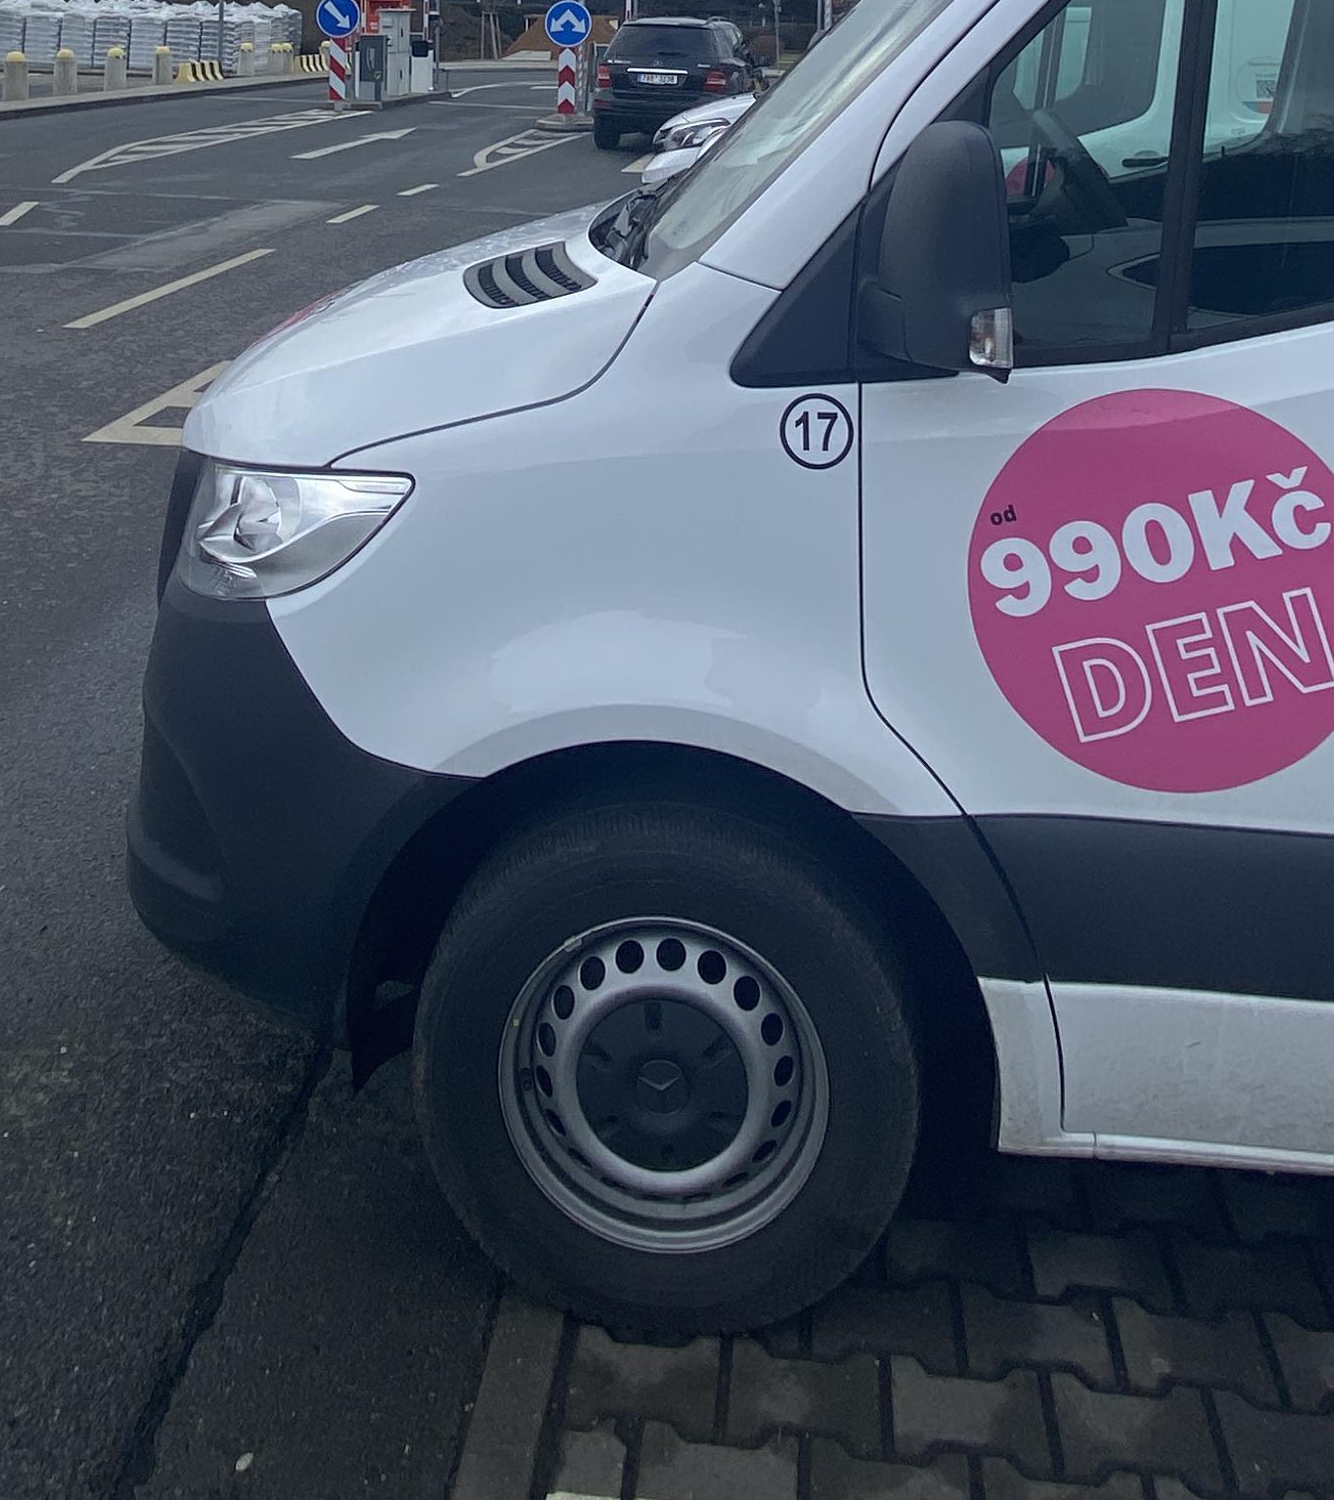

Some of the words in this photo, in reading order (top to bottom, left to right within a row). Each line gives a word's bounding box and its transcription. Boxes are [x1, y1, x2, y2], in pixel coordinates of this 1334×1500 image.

[795, 411, 838, 451] 17
[990, 504, 1017, 526] od
[980, 465, 1332, 617] 990Kč
